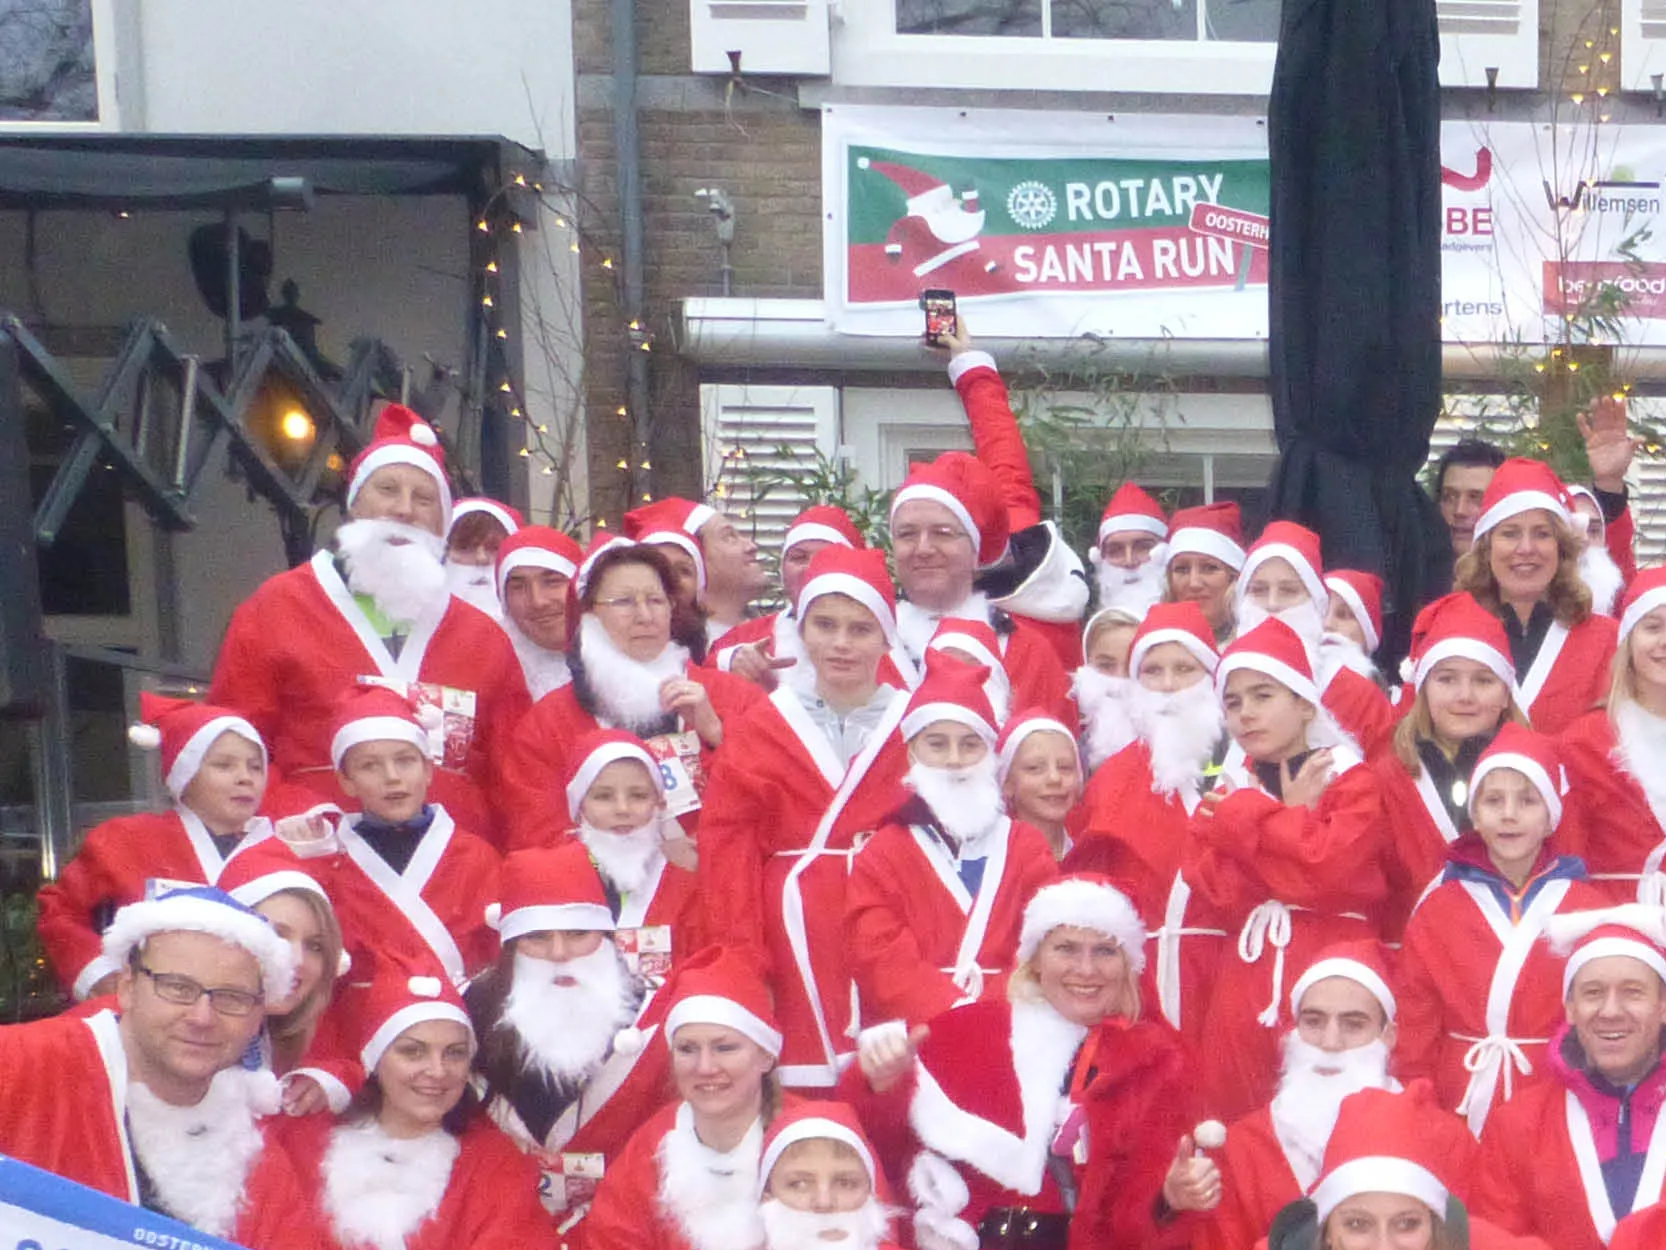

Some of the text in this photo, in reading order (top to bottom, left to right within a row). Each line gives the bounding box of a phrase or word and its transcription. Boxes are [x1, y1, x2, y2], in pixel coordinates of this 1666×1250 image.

[1066, 173, 1224, 221] ROTARY
[1014, 236, 1235, 283] SANTA RUN
